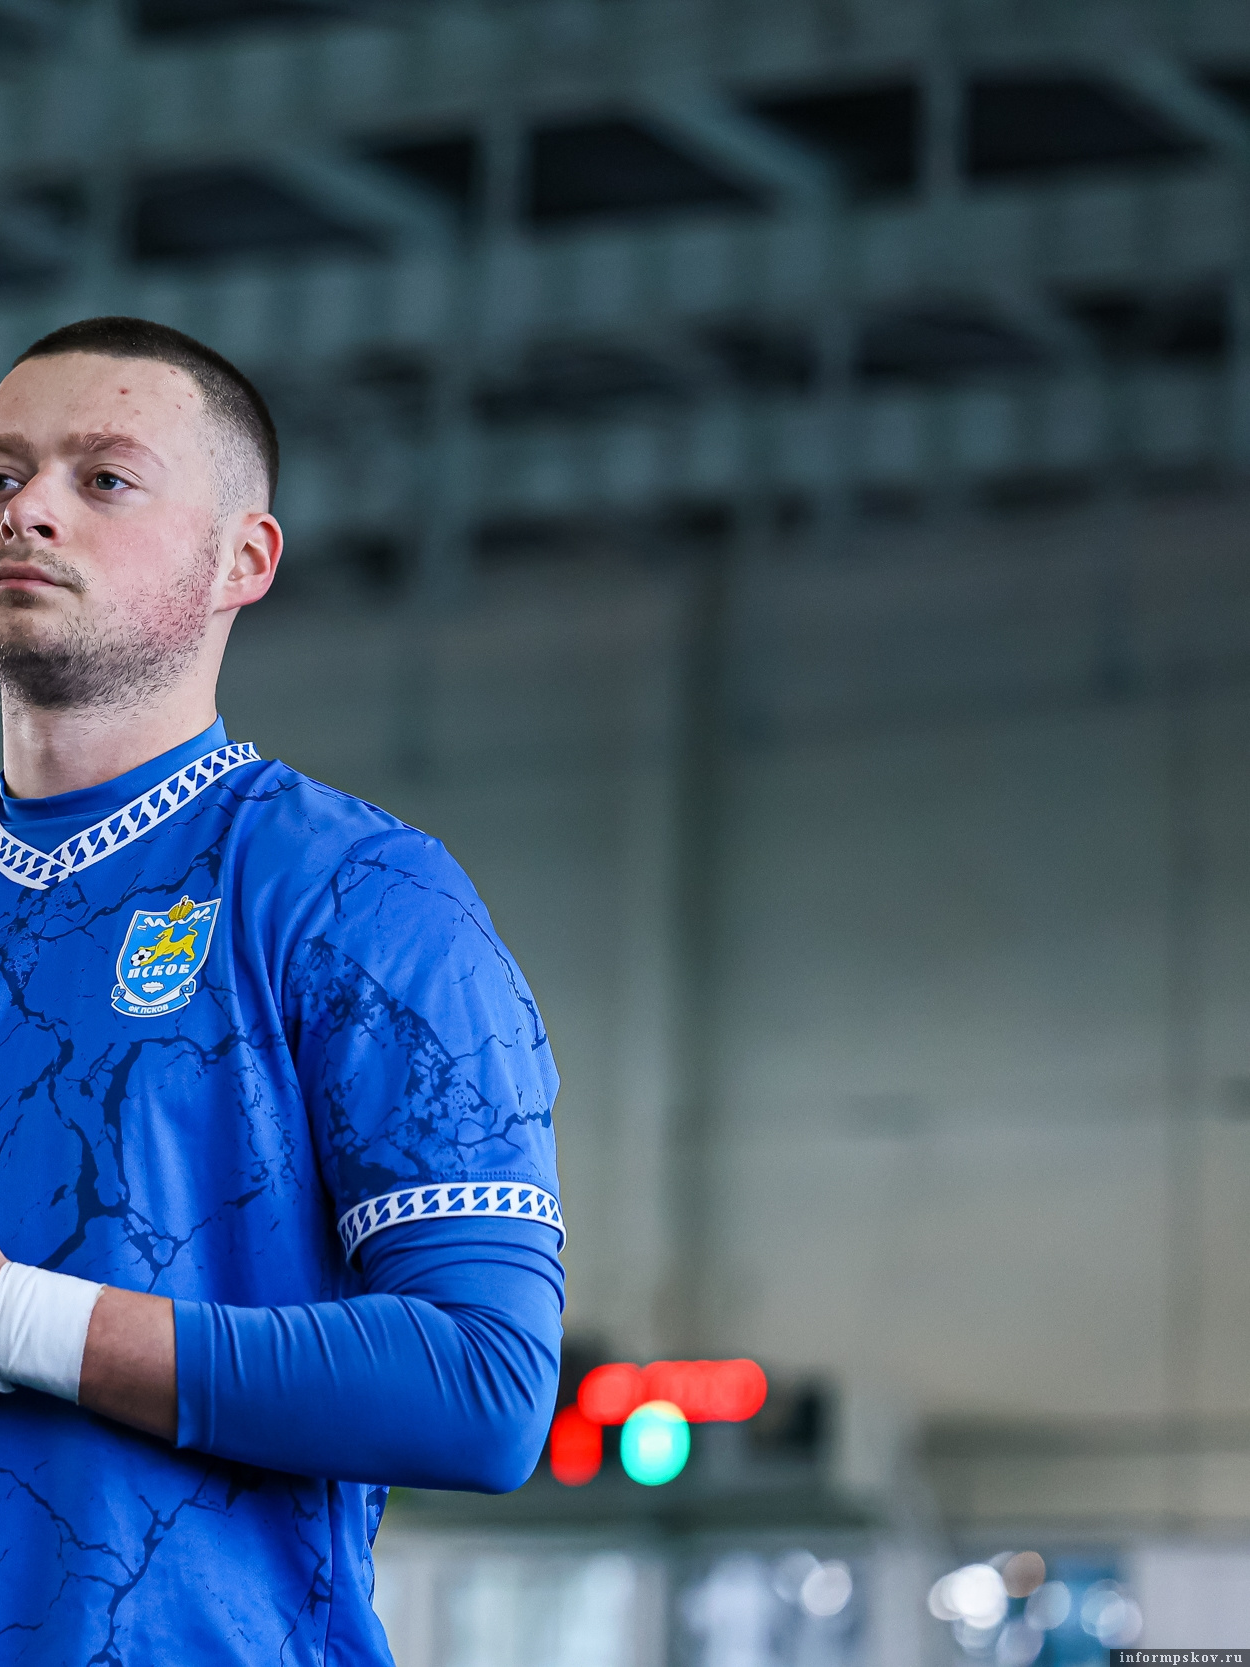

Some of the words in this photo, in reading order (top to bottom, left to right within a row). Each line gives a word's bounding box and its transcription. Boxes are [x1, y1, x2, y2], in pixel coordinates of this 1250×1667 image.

[127, 963, 190, 978] ПСКОВ
[128, 1005, 140, 1013] ФК
[141, 1004, 169, 1013] ПСКОВ
